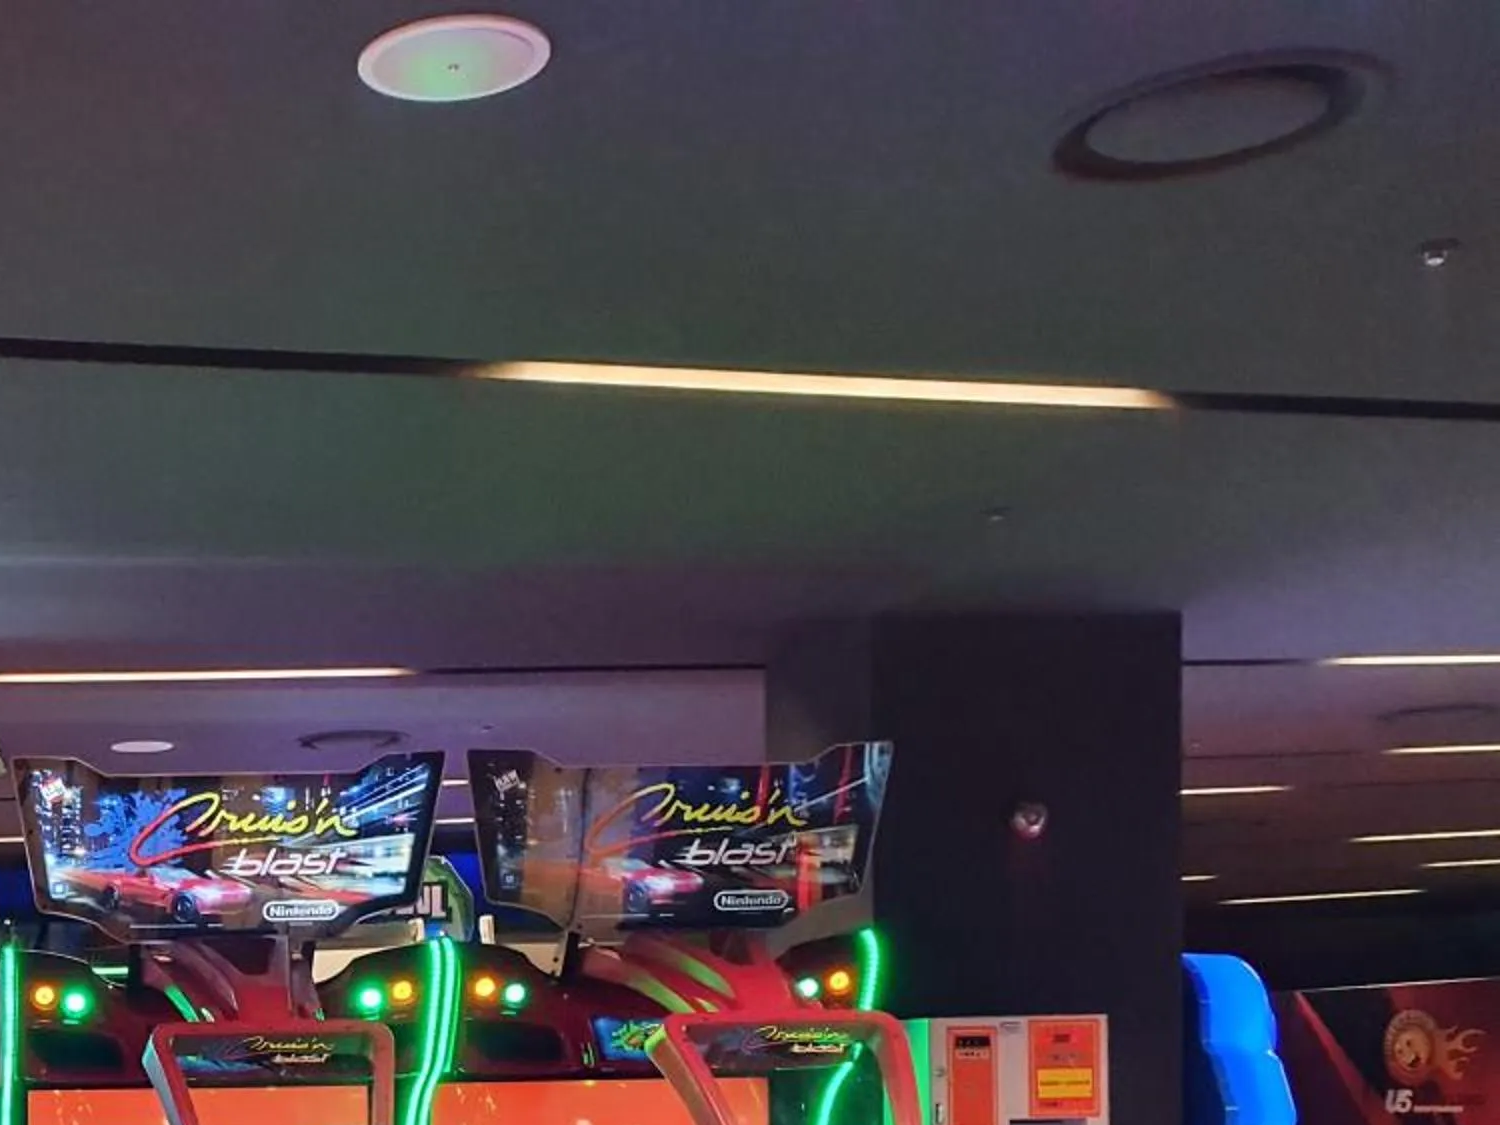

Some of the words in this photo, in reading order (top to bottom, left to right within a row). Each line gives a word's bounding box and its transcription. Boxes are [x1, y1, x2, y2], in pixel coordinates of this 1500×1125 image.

[129, 791, 358, 867] Cruis'n
[585, 782, 806, 855] Cruis'n
[223, 848, 346, 877] blast
[674, 836, 799, 867] blast
[268, 903, 335, 918] Nintendo
[718, 892, 783, 907] Nintendo
